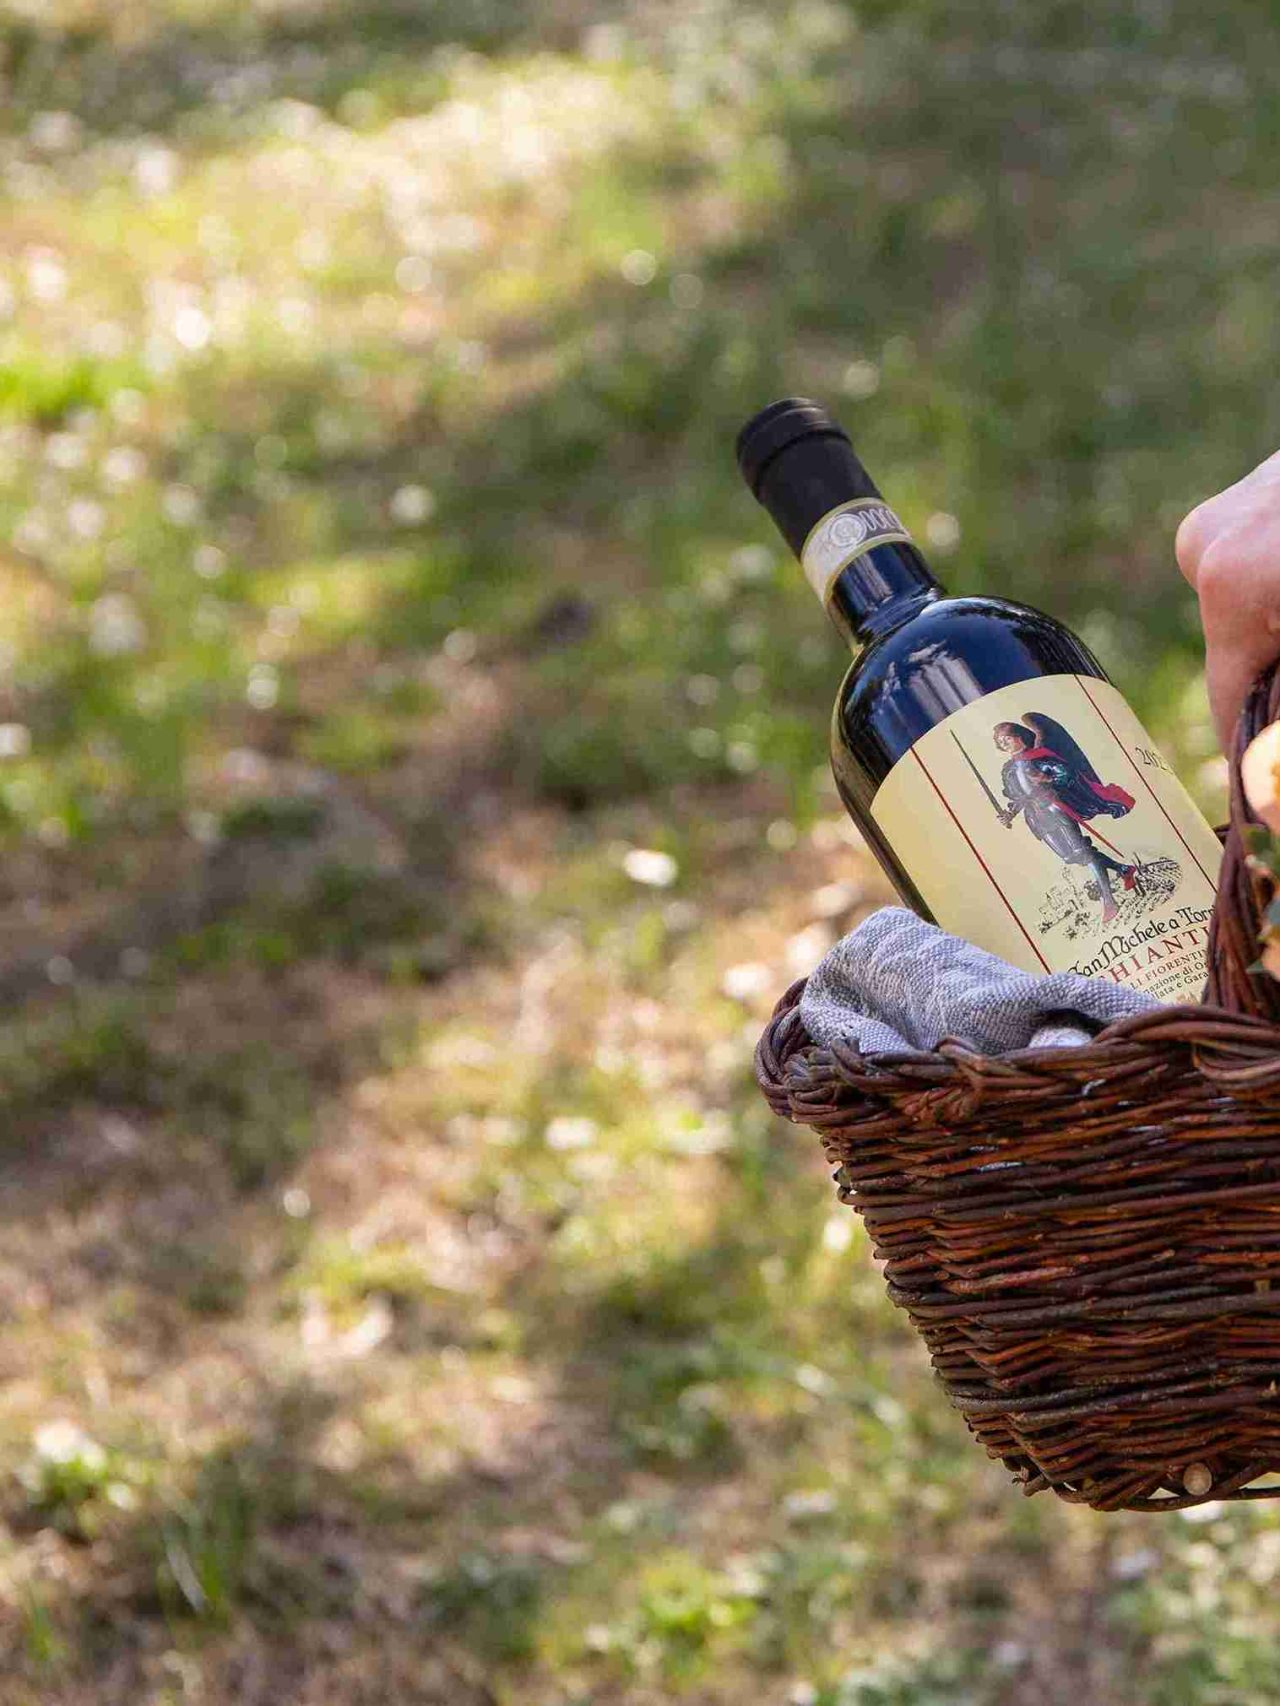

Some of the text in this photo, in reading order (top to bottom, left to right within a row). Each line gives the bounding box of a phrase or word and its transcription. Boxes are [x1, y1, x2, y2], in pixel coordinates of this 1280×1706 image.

[1098, 919, 1168, 969] Michele
[1168, 918, 1181, 930] a
[1100, 926, 1209, 984] HIANTI
